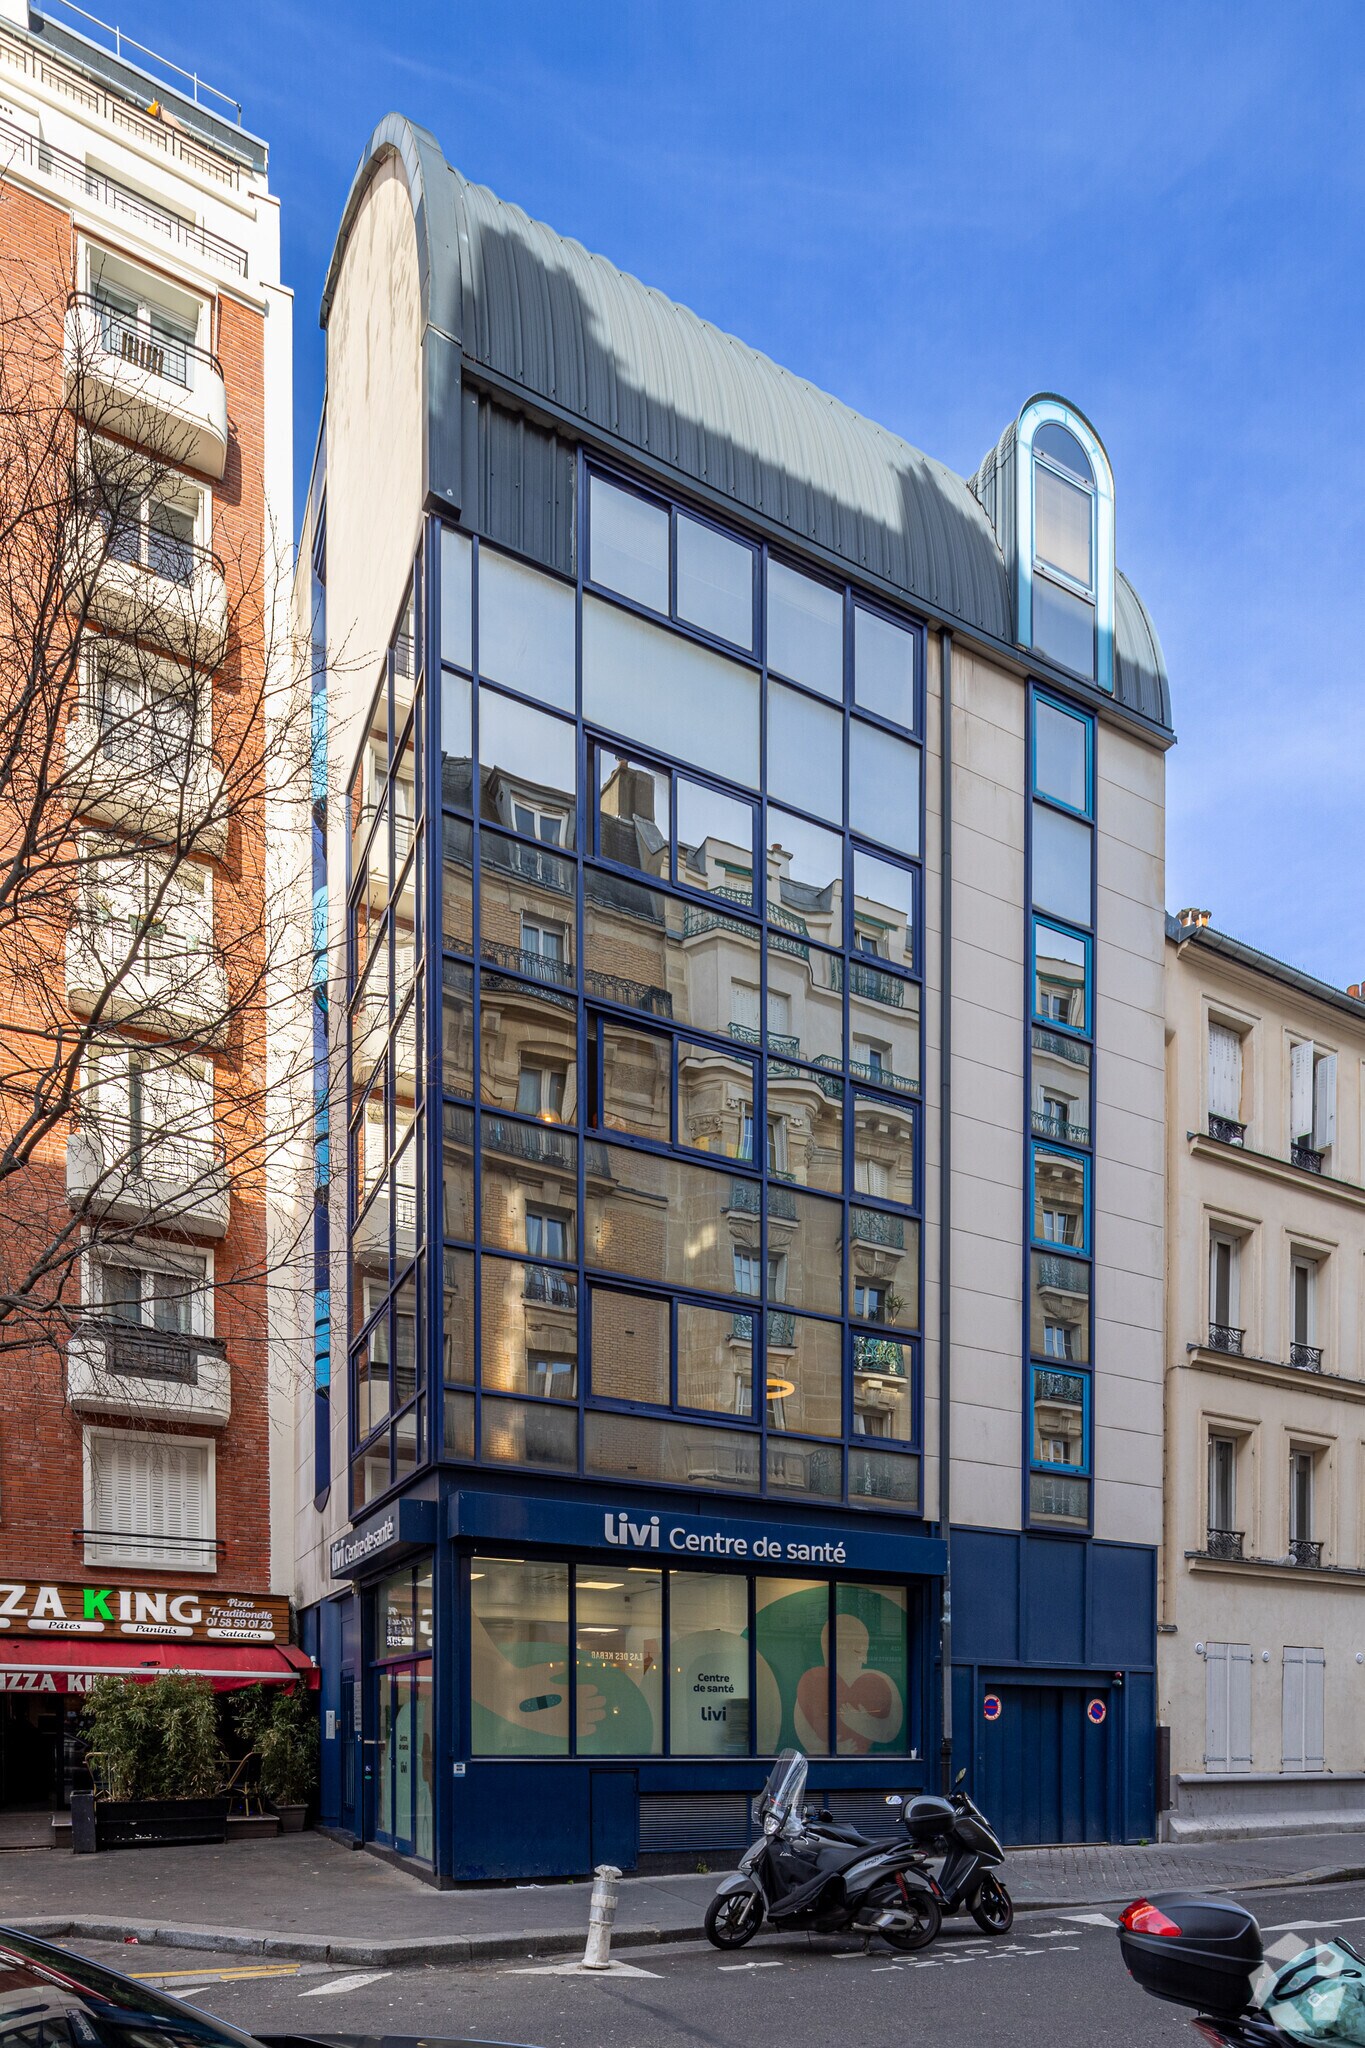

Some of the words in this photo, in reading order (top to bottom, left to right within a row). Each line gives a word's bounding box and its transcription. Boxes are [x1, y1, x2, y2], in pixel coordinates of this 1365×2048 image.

[345, 1540, 365, 1565] Centre
[364, 1532, 374, 1553] de
[373, 1515, 394, 1549] santé
[669, 1527, 748, 1555] Centre
[752, 1536, 782, 1558] de
[787, 1541, 846, 1564] santé
[81, 1588, 202, 1624] KING
[227, 1598, 255, 1609] Pizza
[209, 1607, 273, 1620] Traditionelle
[48, 1621, 81, 1630] Pâtes
[205, 1617, 217, 1627] 01
[218, 1618, 232, 1628] 58
[233, 1619, 246, 1628] 59
[247, 1620, 258, 1629] 01
[259, 1620, 274, 1630] 20
[135, 1624, 178, 1635] Paninis
[219, 1629, 262, 1639] Salades
[697, 1672, 730, 1683] Centre
[693, 1684, 706, 1692] de
[707, 1684, 735, 1693] santé
